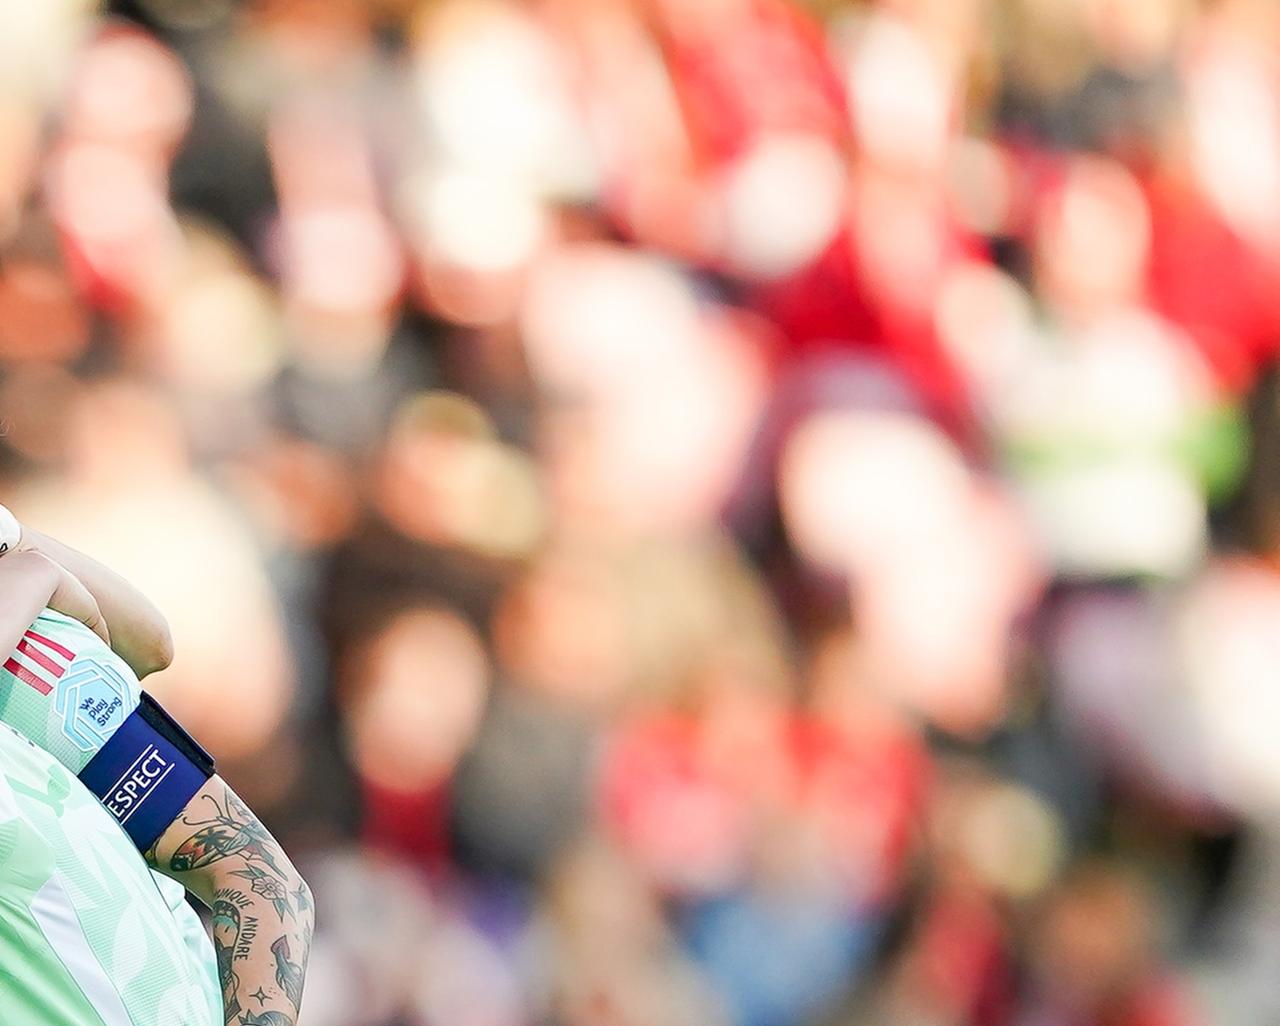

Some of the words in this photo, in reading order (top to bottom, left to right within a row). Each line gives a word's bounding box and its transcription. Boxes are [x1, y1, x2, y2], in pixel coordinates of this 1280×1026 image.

[89, 699, 108, 720] play
[97, 697, 123, 726] Strong
[107, 749, 167, 818] ESPECT
[234, 915, 259, 961] ANDARE
